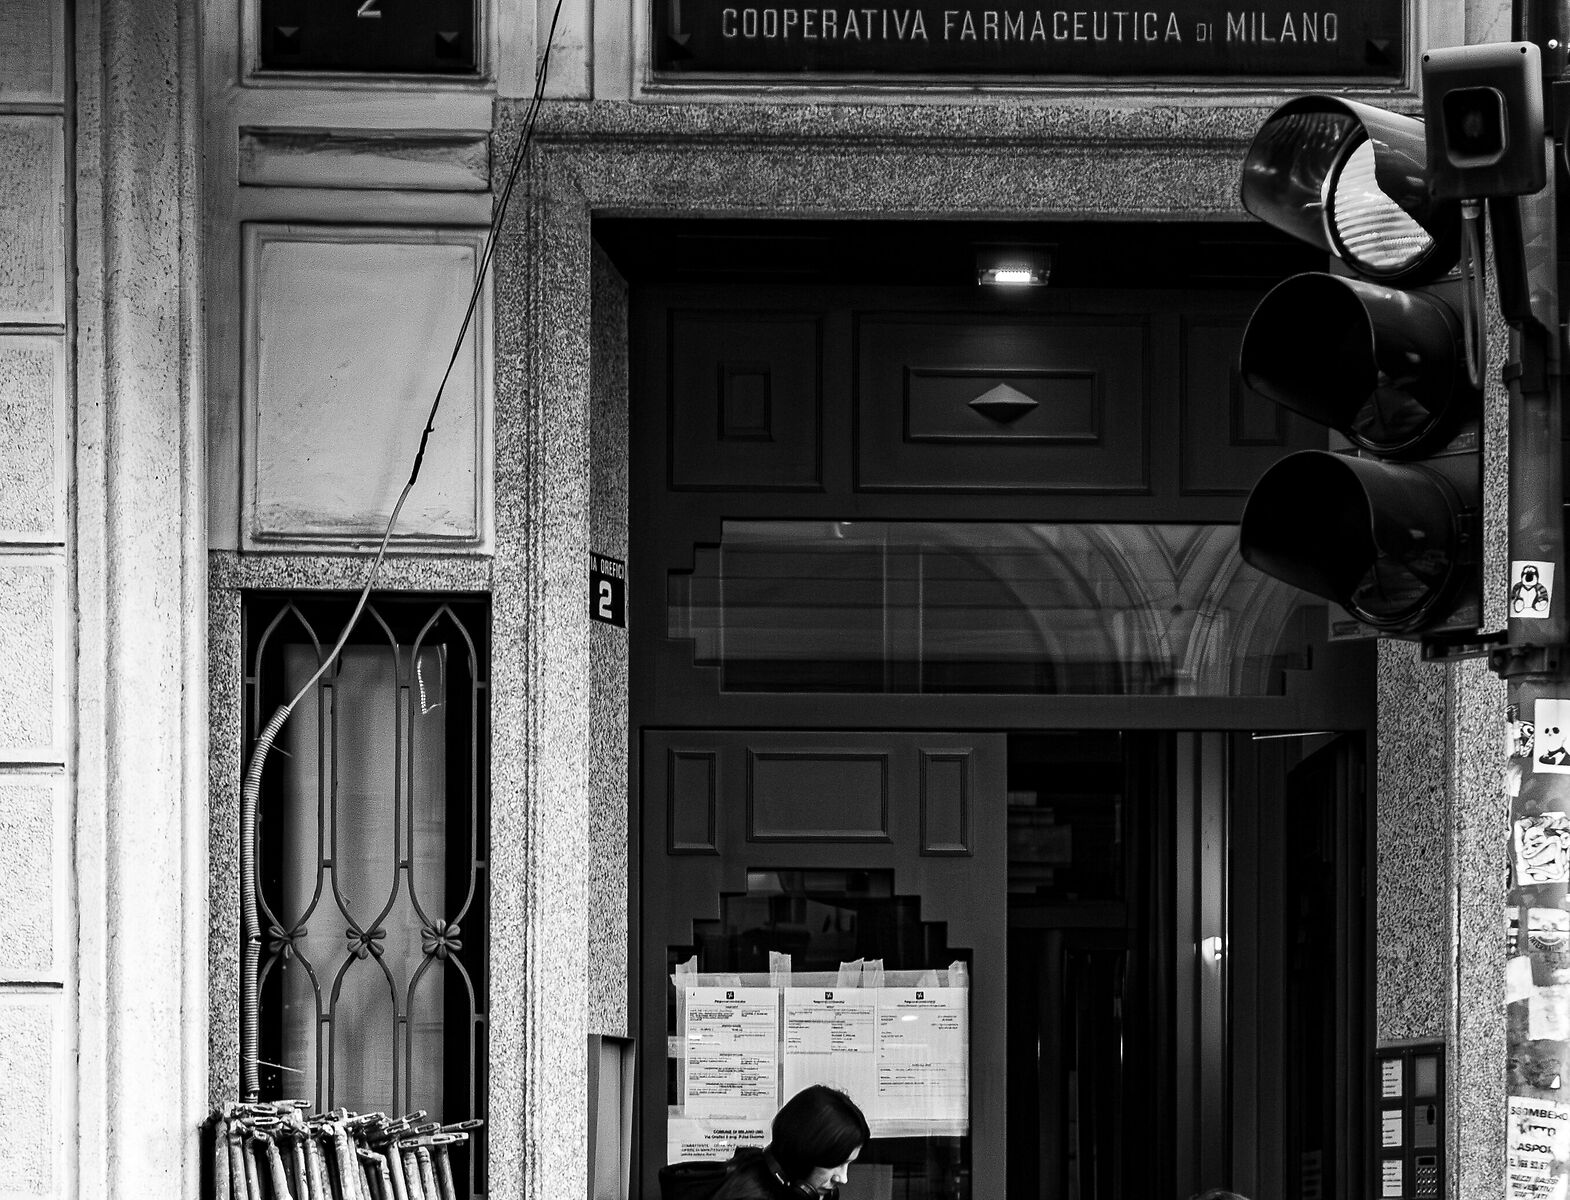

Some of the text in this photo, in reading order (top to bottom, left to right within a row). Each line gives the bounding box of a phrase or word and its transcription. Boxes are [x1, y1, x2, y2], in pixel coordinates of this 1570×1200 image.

[722, 8, 1338, 42] COOPERATIVA FARMACEUTICA DI MILANO
[599, 580, 612, 619] 2
